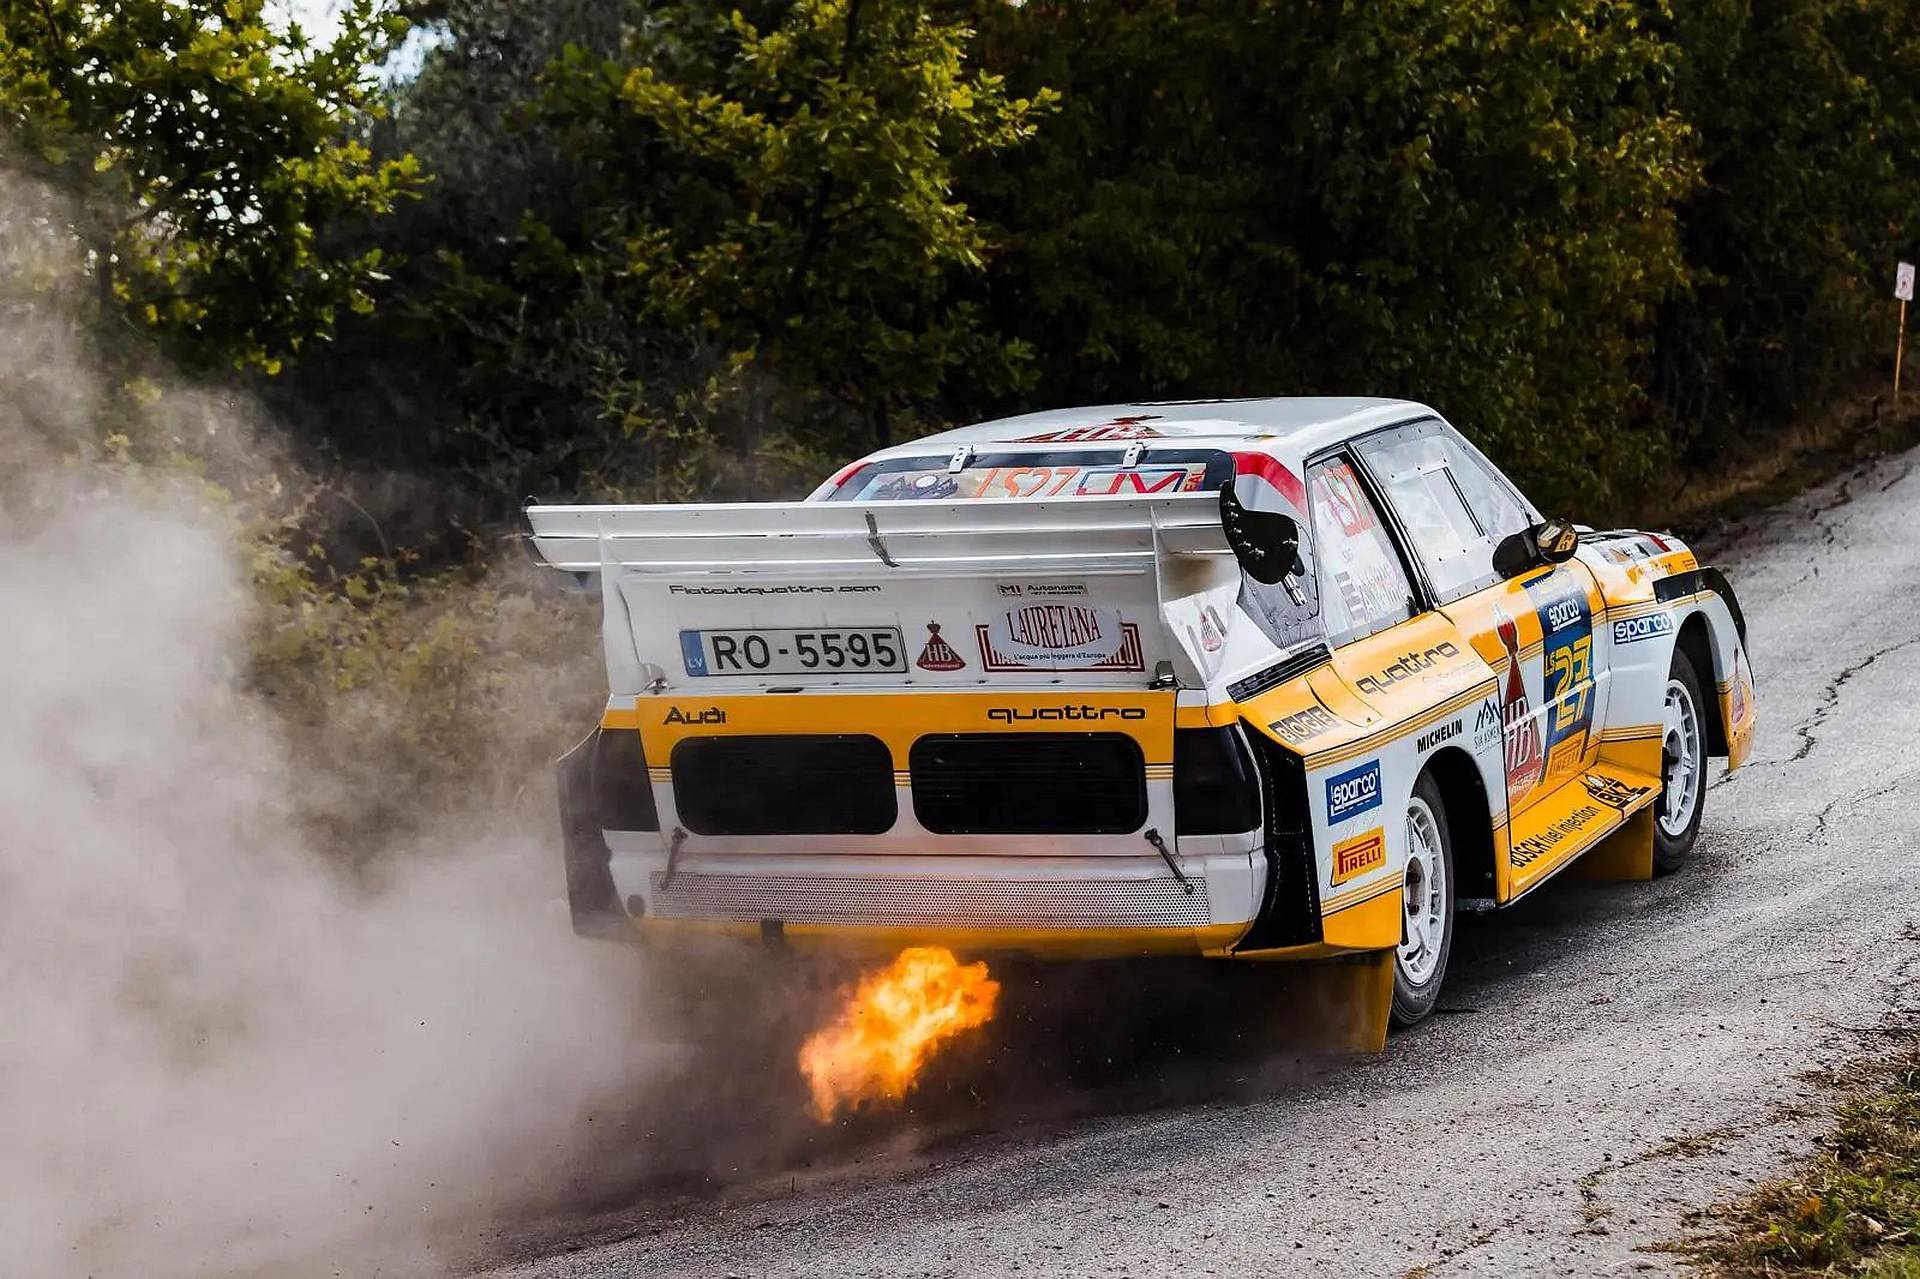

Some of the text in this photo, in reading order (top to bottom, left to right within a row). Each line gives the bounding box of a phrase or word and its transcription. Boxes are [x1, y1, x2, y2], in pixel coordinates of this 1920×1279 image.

[1006, 605, 1102, 648] LAURETANA
[1615, 614, 1670, 642] sparco
[927, 643, 953, 661] HB
[1356, 642, 1460, 695] quattro
[663, 707, 727, 725] Audi
[987, 705, 1146, 724] quattro
[1273, 709, 1337, 742] BOGE
[1417, 719, 1462, 754] MICHELIN
[1333, 771, 1377, 808] sparco
[1541, 824, 1565, 848] fuel
[1559, 806, 1602, 833] injection
[1338, 836, 1381, 875] PIRELLI
